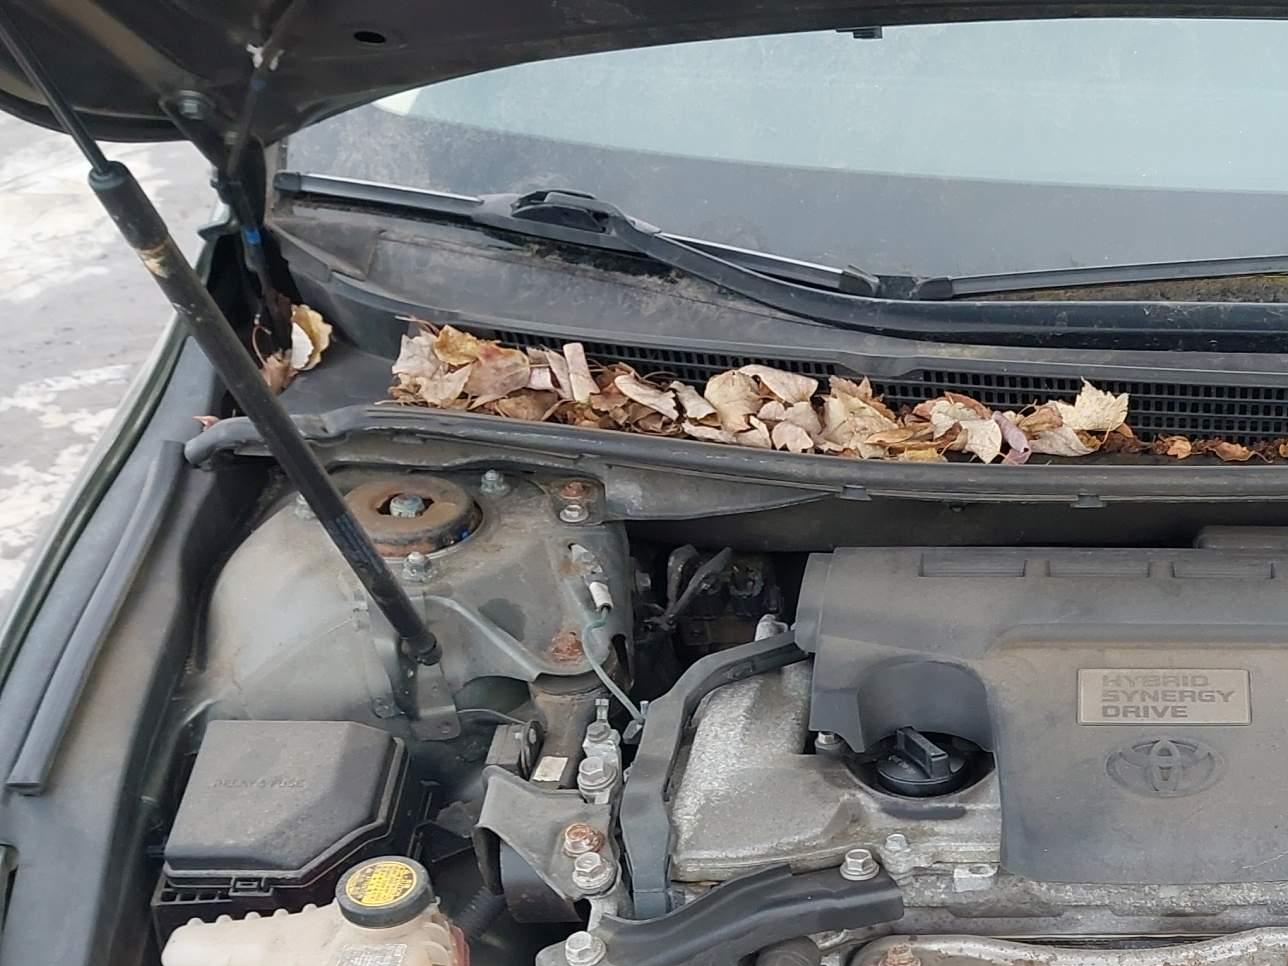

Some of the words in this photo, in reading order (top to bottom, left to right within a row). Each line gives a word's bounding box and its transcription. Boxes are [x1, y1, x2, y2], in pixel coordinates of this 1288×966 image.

[1102, 674, 1209, 688] HYBRID
[1101, 689, 1235, 703] SYNERGY
[1101, 705, 1188, 719] DRIVE
